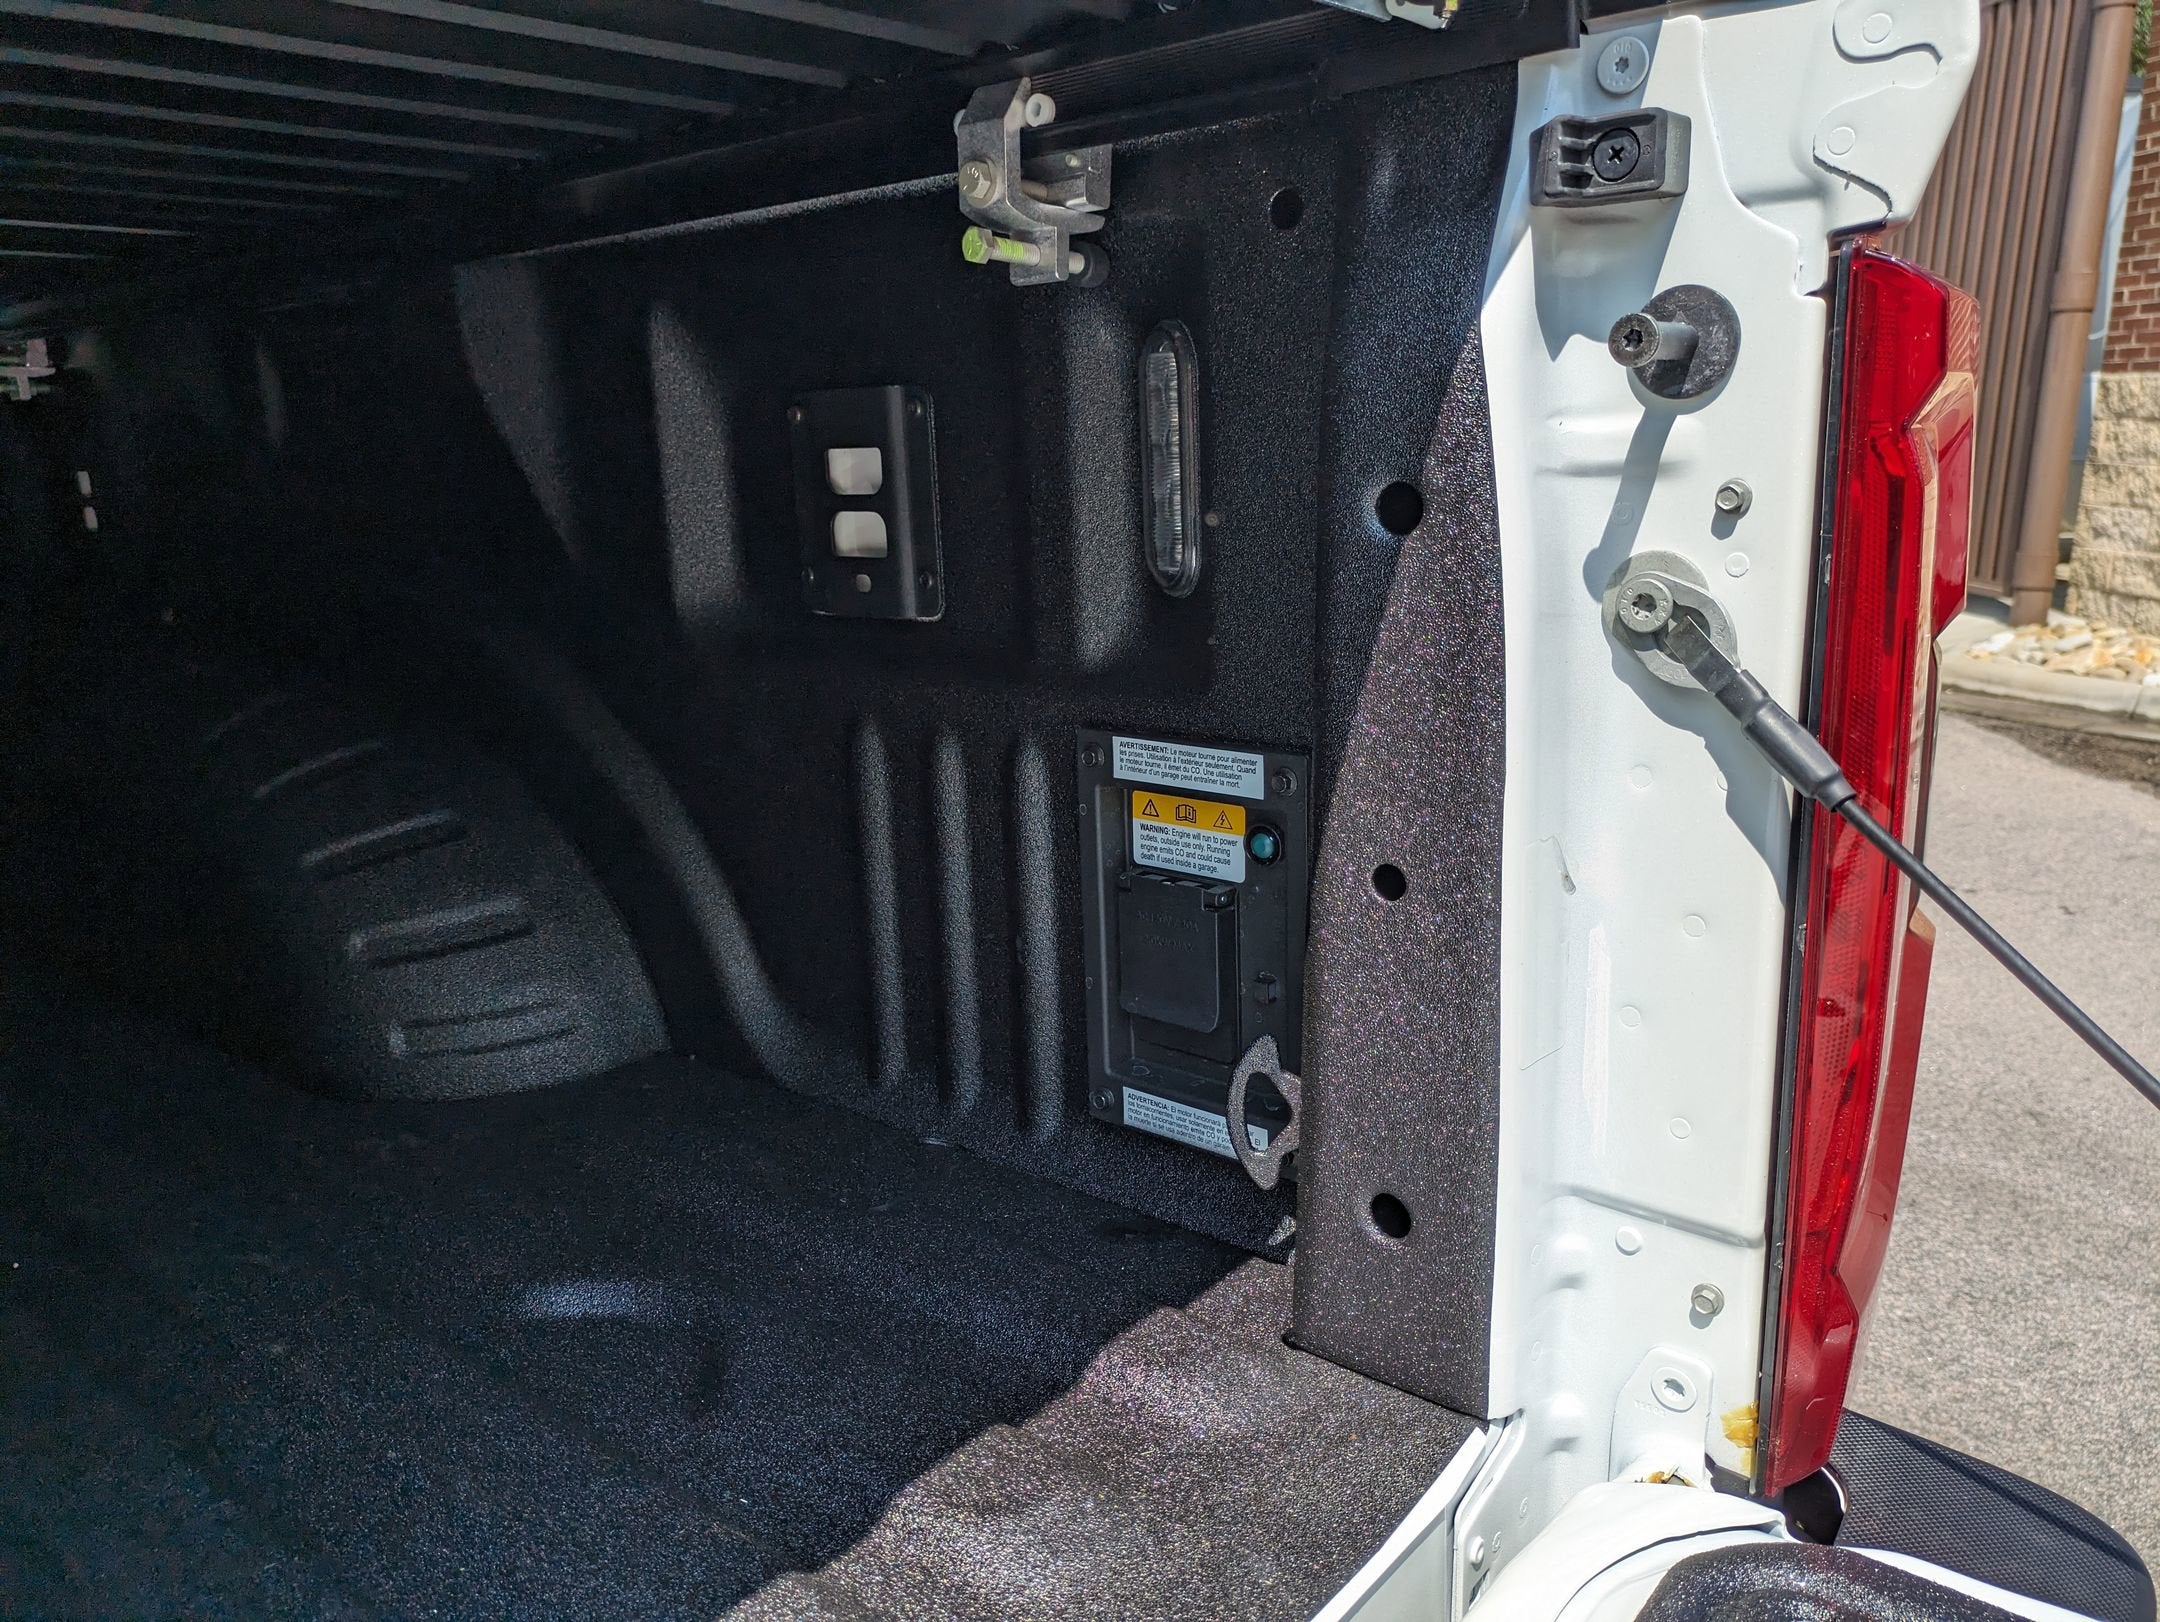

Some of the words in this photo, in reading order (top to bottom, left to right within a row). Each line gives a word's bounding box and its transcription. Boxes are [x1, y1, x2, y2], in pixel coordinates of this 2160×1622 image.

[1120, 741, 1168, 754] AVERTISSEMENT:
[1178, 750, 1197, 758] moteur
[1198, 752, 1215, 760] tourne
[1217, 755, 1229, 763] pour
[1231, 758, 1257, 766] alimenter
[1147, 753, 1171, 762] Utilisation
[1178, 756, 1203, 766] l'extérieur
[1205, 761, 1234, 770] seulement.
[1237, 765, 1256, 774] Quand
[1124, 765, 1147, 773] l'intérieur
[1161, 771, 1179, 780] garage
[1168, 764, 1181, 772] émet
[1191, 767, 1201, 775] CO.
[1216, 771, 1242, 780] utilisation
[1140, 823, 1170, 835] WARNING:
[1172, 829, 1190, 839] Engine
[1213, 836, 1218, 844] to
[1220, 838, 1237, 847] power
[1140, 834, 1159, 844] outlets,
[1160, 837, 1179, 847] outside
[1182, 841, 1191, 849] use
[1207, 844, 1230, 857] Running
[1140, 843, 1158, 852] engine
[1160, 847, 1174, 855] emits
[1175, 848, 1184, 857] CO
[1186, 851, 1196, 859] and
[1197, 853, 1212, 862] could
[1214, 857, 1231, 865] cause
[1141, 852, 1155, 860] death
[1161, 856, 1174, 864] used
[1176, 858, 1191, 868] inside
[1198, 863, 1219, 874] garage.
[1128, 1093, 1170, 1111] ADVERTENCIA:
[1194, 1112, 1221, 1126] funcionará
[1128, 1108, 1142, 1116] motor
[1151, 1114, 1189, 1131] funcionamiento
[1189, 1119, 1215, 1131] solamente
[1254, 1138, 1260, 1146] El
